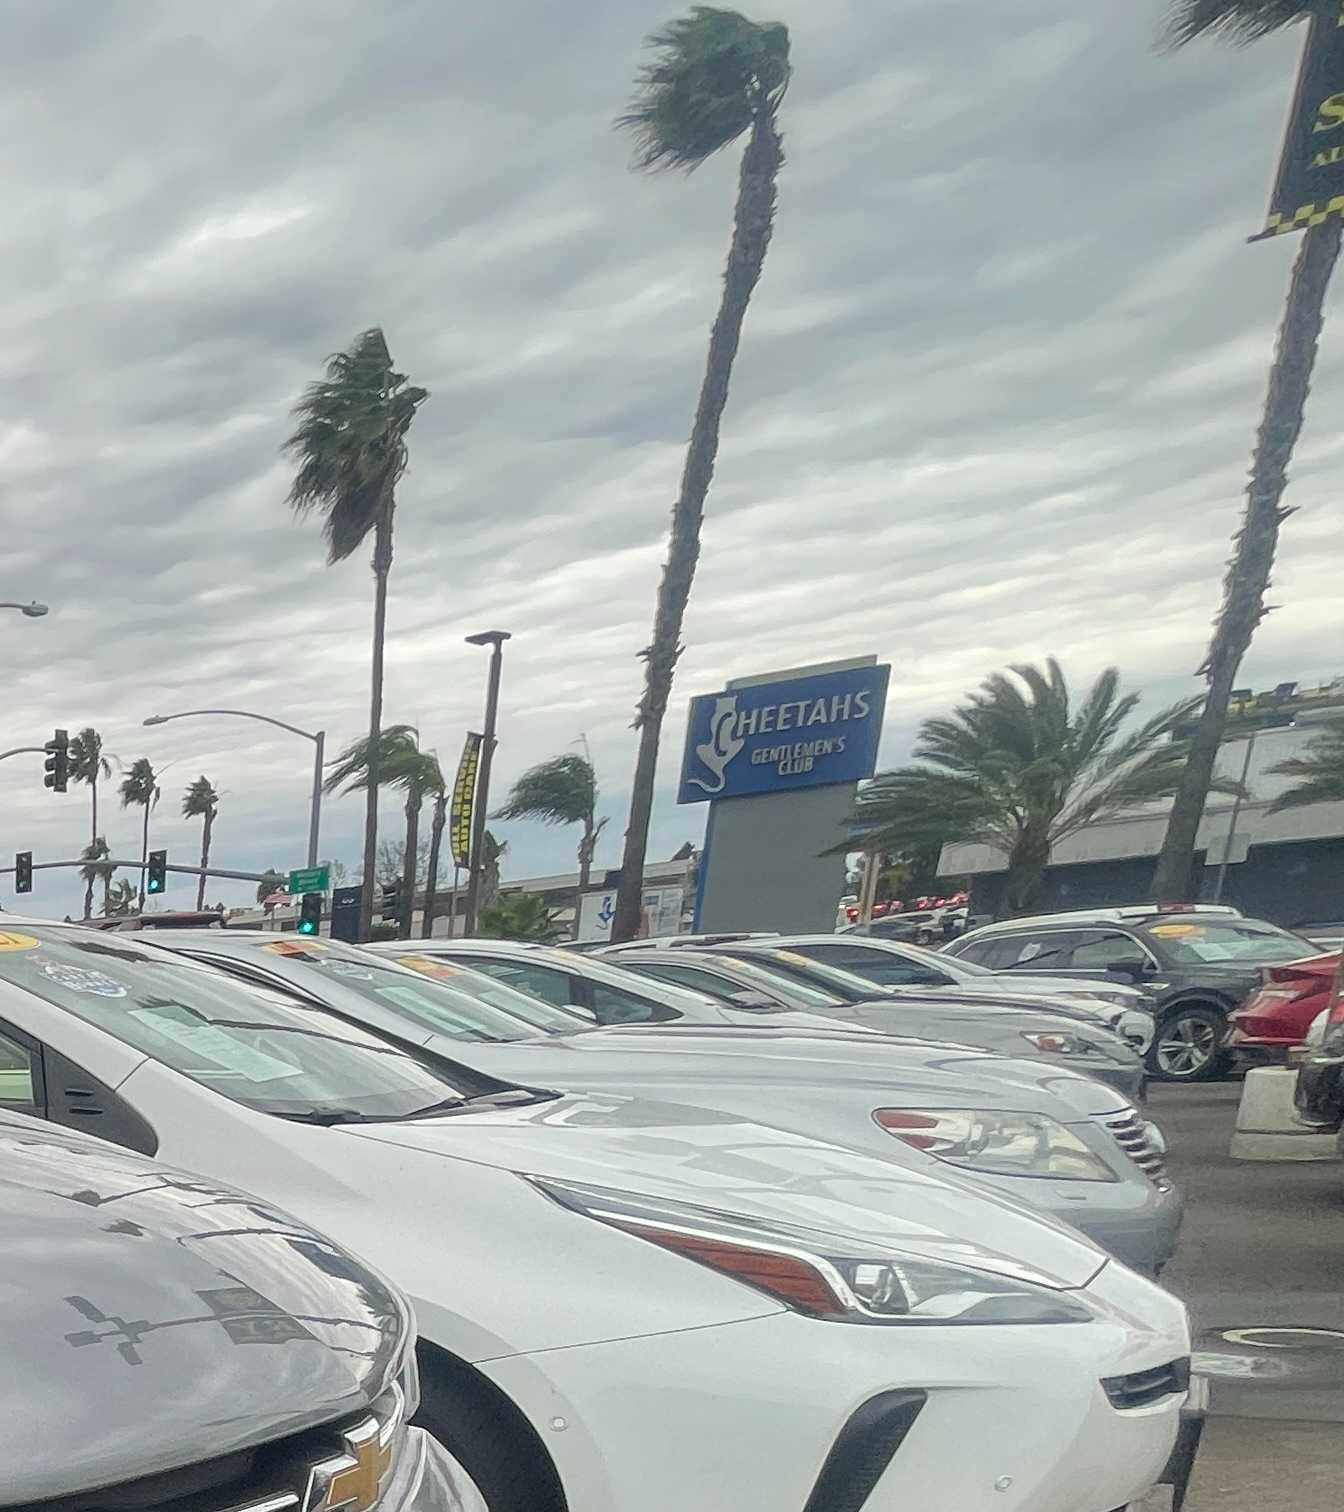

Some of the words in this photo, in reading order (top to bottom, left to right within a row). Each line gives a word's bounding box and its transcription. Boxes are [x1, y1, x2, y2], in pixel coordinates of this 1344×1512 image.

[714, 691, 870, 756] CHEETAHS
[751, 736, 847, 765] GENTLEMEN'S
[778, 757, 815, 776] CLUB
